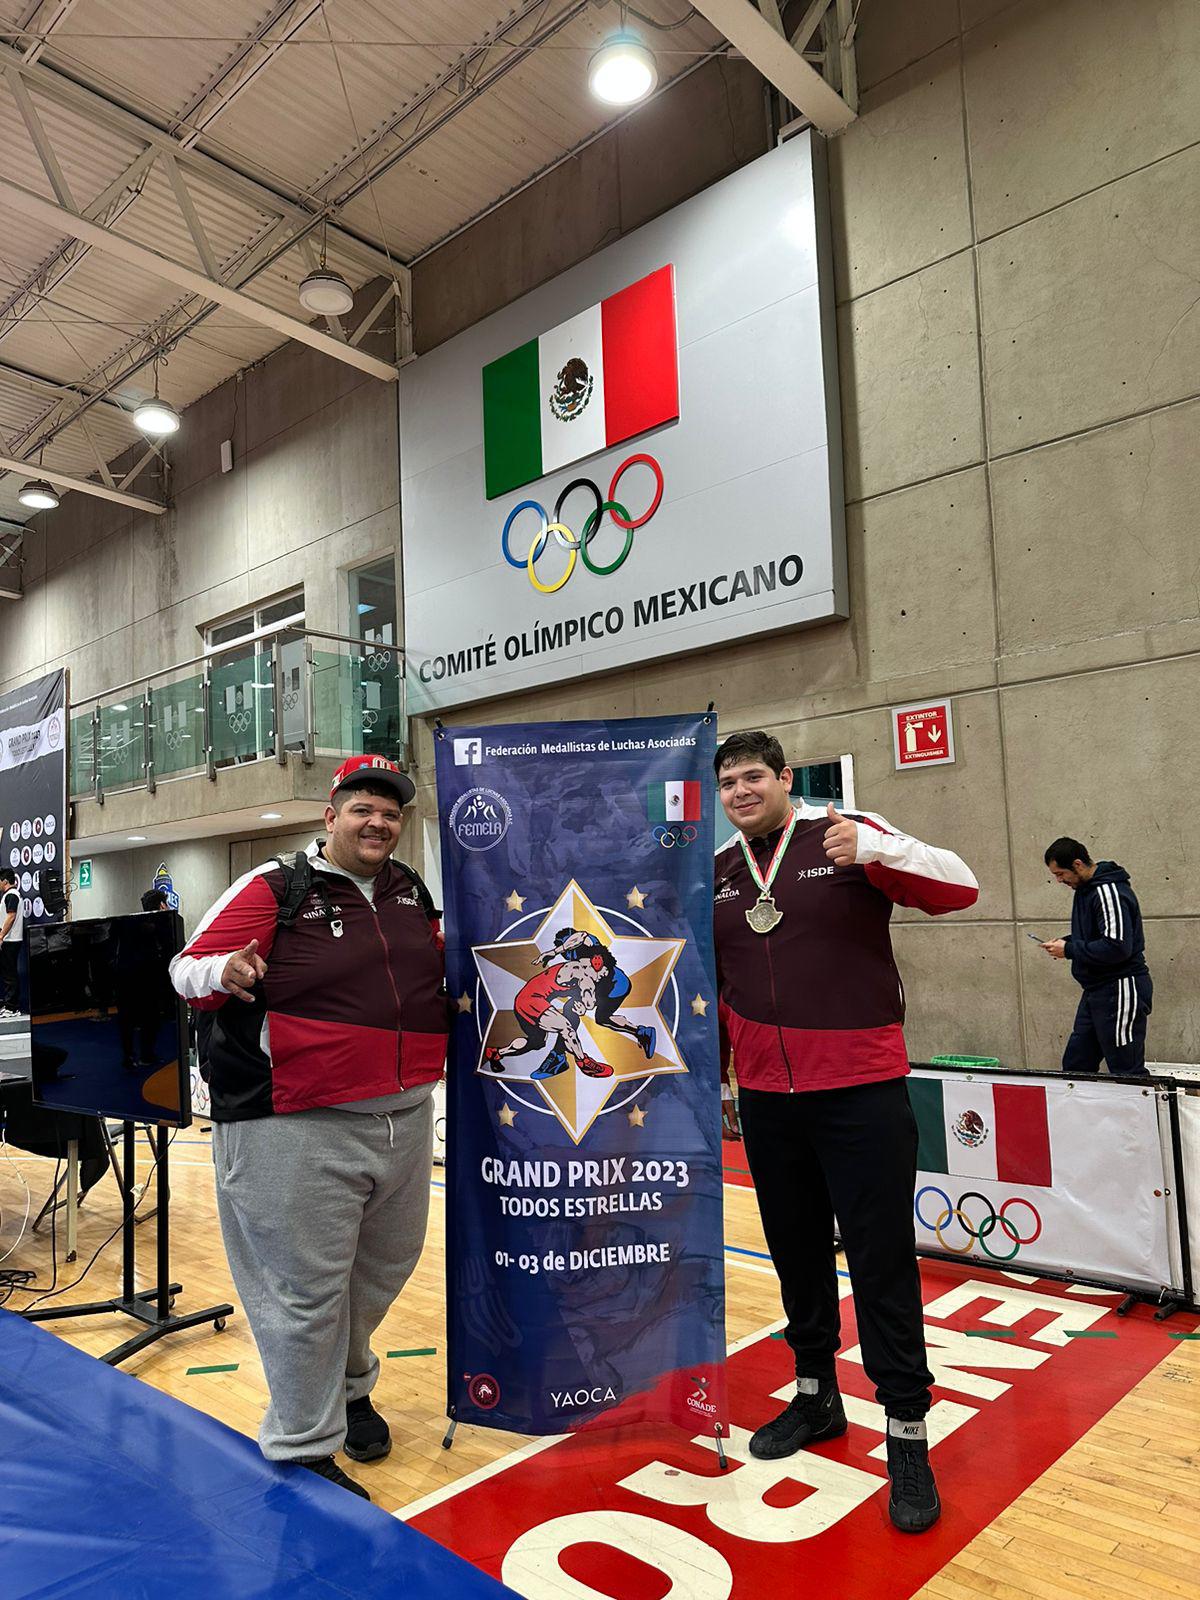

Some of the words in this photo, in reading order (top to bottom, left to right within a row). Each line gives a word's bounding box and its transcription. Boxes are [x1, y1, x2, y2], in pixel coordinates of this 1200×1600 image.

[419, 634, 497, 683] COMITÉ
[504, 606, 624, 662] OLÍMPICO
[633, 554, 804, 628] MEXICANO
[905, 711, 938, 721] EXTINTOR
[485, 743, 538, 756] Federación
[541, 741, 596, 754] Medallistas
[597, 740, 610, 751] de
[611, 738, 646, 751] Luchas
[647, 736, 697, 749] Asociadas
[904, 749, 944, 760] EXTINGUISHER
[458, 821, 502, 837] FEMELA
[807, 865, 835, 878] ISDE
[481, 1156, 562, 1188] GRAND
[568, 1157, 627, 1188] PRIX
[631, 1160, 690, 1188] 2023
[499, 1196, 560, 1217] TODOS
[564, 1192, 663, 1218] ESTRELLAS
[495, 1251, 515, 1267] 01-
[518, 1254, 539, 1274] 03
[543, 1250, 565, 1270] de
[569, 1243, 671, 1270] DICIEMBRE
[550, 1387, 616, 1408] YAOCA
[686, 1397, 717, 1413] CONADE
[902, 1425, 920, 1435] NIKE
